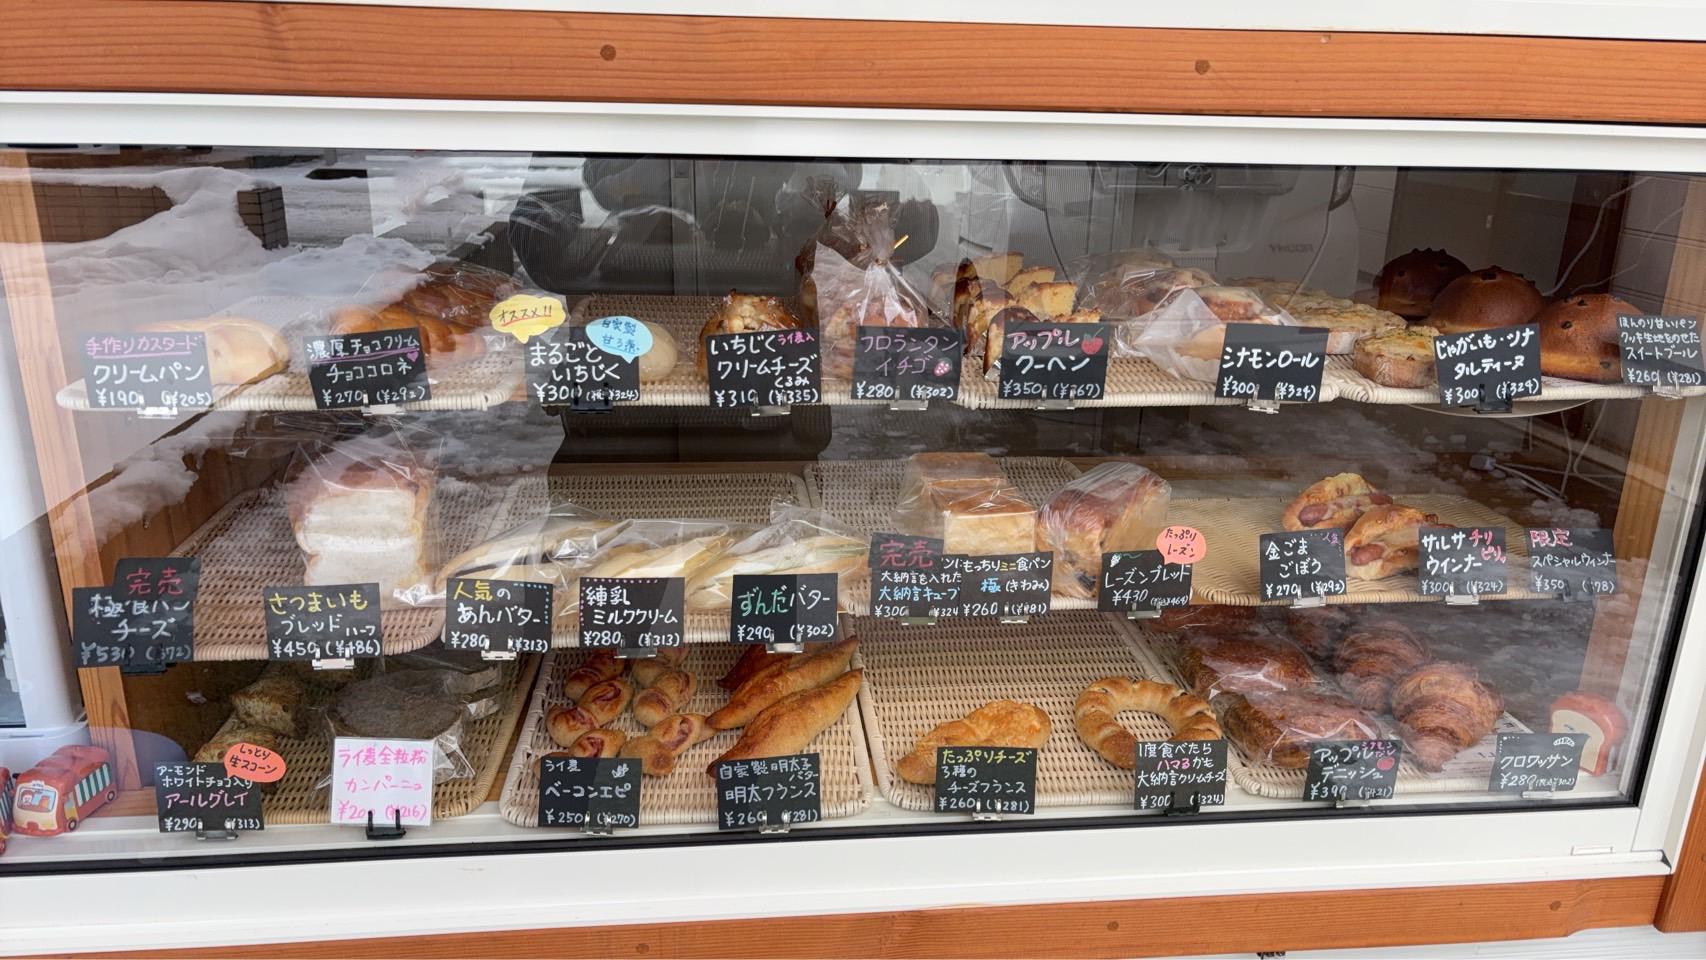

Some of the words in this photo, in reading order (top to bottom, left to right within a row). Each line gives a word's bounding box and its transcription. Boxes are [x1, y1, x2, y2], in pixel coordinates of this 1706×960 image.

[498, 305, 552, 322] オススメ!!
[1619, 316, 1697, 329] ほんのり甘いパン
[602, 318, 637, 336] 自家製
[85, 335, 203, 356] 手作りカスタード
[307, 334, 420, 359] 濃厚チョコクリーム
[711, 335, 776, 355] いちじく
[861, 334, 958, 354] フロランタン
[1007, 328, 1080, 350] アップル
[1435, 327, 1535, 360] じゃがいも・ツナ
[529, 342, 602, 366] まるごと
[1222, 346, 1320, 369] シナモンロール
[1625, 344, 1698, 360] スイートブール
[93, 361, 205, 384] クリームパン
[326, 357, 412, 383] チョココロネ
[552, 363, 620, 383] いちじく
[718, 354, 817, 379] クリームチーズ
[875, 355, 933, 376] イチゴ
[1015, 355, 1090, 374] クーヘン
[1454, 355, 1525, 380] タルティーヌ
[775, 377, 809, 388] くるみ
[1627, 367, 1658, 383] ¥260
[1667, 370, 1702, 385] (¥281)
[533, 383, 582, 402] ¥300
[857, 380, 894, 399] ¥280
[910, 384, 954, 399] (¥302)
[1003, 379, 1042, 397] ¥350
[1222, 375, 1256, 396] ¥300
[1444, 387, 1479, 404] ¥300
[1495, 378, 1539, 399] (¥324)
[95, 388, 140, 406] ¥190
[322, 389, 364, 406] ¥270
[376, 385, 426, 404] (¥292)
[714, 390, 757, 407] ¥310
[768, 388, 819, 405] (¥335)
[1165, 528, 1197, 541] たっぷり
[1422, 531, 1466, 552] サルサ
[1469, 529, 1493, 547] チリ
[1530, 528, 1573, 548] 限定
[879, 539, 933, 568] 完売
[1167, 544, 1195, 558] レーズン
[1265, 537, 1308, 560] 金ごま
[963, 557, 1051, 572] もっちりミニ食パン
[1279, 557, 1321, 578] ごぼう
[1426, 554, 1482, 575] ウインナー
[1531, 552, 1616, 567] スペシャルウィンナー
[126, 567, 183, 595] 完売
[880, 571, 962, 585] 大納言を入れた
[1105, 563, 1190, 588] レーズンブレッド
[1535, 575, 1565, 592] ¥350
[453, 580, 511, 601] 人気の
[981, 577, 1001, 593] 極
[1005, 578, 1050, 592] (きわみ)
[1266, 583, 1298, 598] ¥270
[1311, 580, 1345, 594] (¥292)
[1421, 579, 1450, 594] ¥300
[269, 590, 367, 614] さつまいも
[585, 584, 631, 607] 練乳
[737, 584, 830, 617] ずんだバター
[1112, 589, 1148, 606] ¥430
[457, 602, 541, 626] あんバター
[593, 608, 678, 625] ミルククリーム
[875, 604, 907, 617] ¥300
[963, 602, 998, 616] ¥260
[111, 617, 176, 641] チーズ
[281, 613, 342, 635] ブレッド
[346, 625, 375, 636] ハーフ
[737, 624, 772, 642] ¥290
[789, 623, 834, 640] (¥302)
[451, 631, 488, 649] ¥280
[584, 630, 621, 646] ¥280
[638, 631, 680, 647] (¥313)
[272, 638, 317, 658] ¥450
[240, 744, 271, 760] しっとり
[338, 746, 429, 768] ライ麦全粒粉
[943, 749, 1032, 764] たっぷりチーズ
[1138, 742, 1212, 758] 1度食べたら
[1314, 745, 1374, 762] アップル
[156, 765, 206, 776] アーモンド
[229, 754, 277, 774] 生スコーン
[545, 759, 581, 772] ライ麦
[719, 757, 812, 780] 自家製明太子
[1157, 756, 1214, 770] ハマるかも
[1500, 754, 1573, 770] クロワッサン
[789, 770, 818, 781] バター
[941, 765, 977, 778] 3種の
[1321, 763, 1383, 783] デニッシュ
[1501, 772, 1537, 789] ¥280
[162, 775, 253, 789] ホワイトチョコ入り
[345, 775, 422, 793] カンパーニュ
[545, 781, 632, 798] ベーコンエピ
[947, 780, 1026, 793] チーズフランス
[165, 790, 248, 808] アールグレイ
[725, 782, 816, 804] 明太フランス
[1140, 795, 1171, 809] ¥300
[939, 796, 975, 810] ¥260
[164, 817, 197, 831] ¥290
[545, 808, 583, 824] ¥250
[725, 811, 764, 827] ¥260
